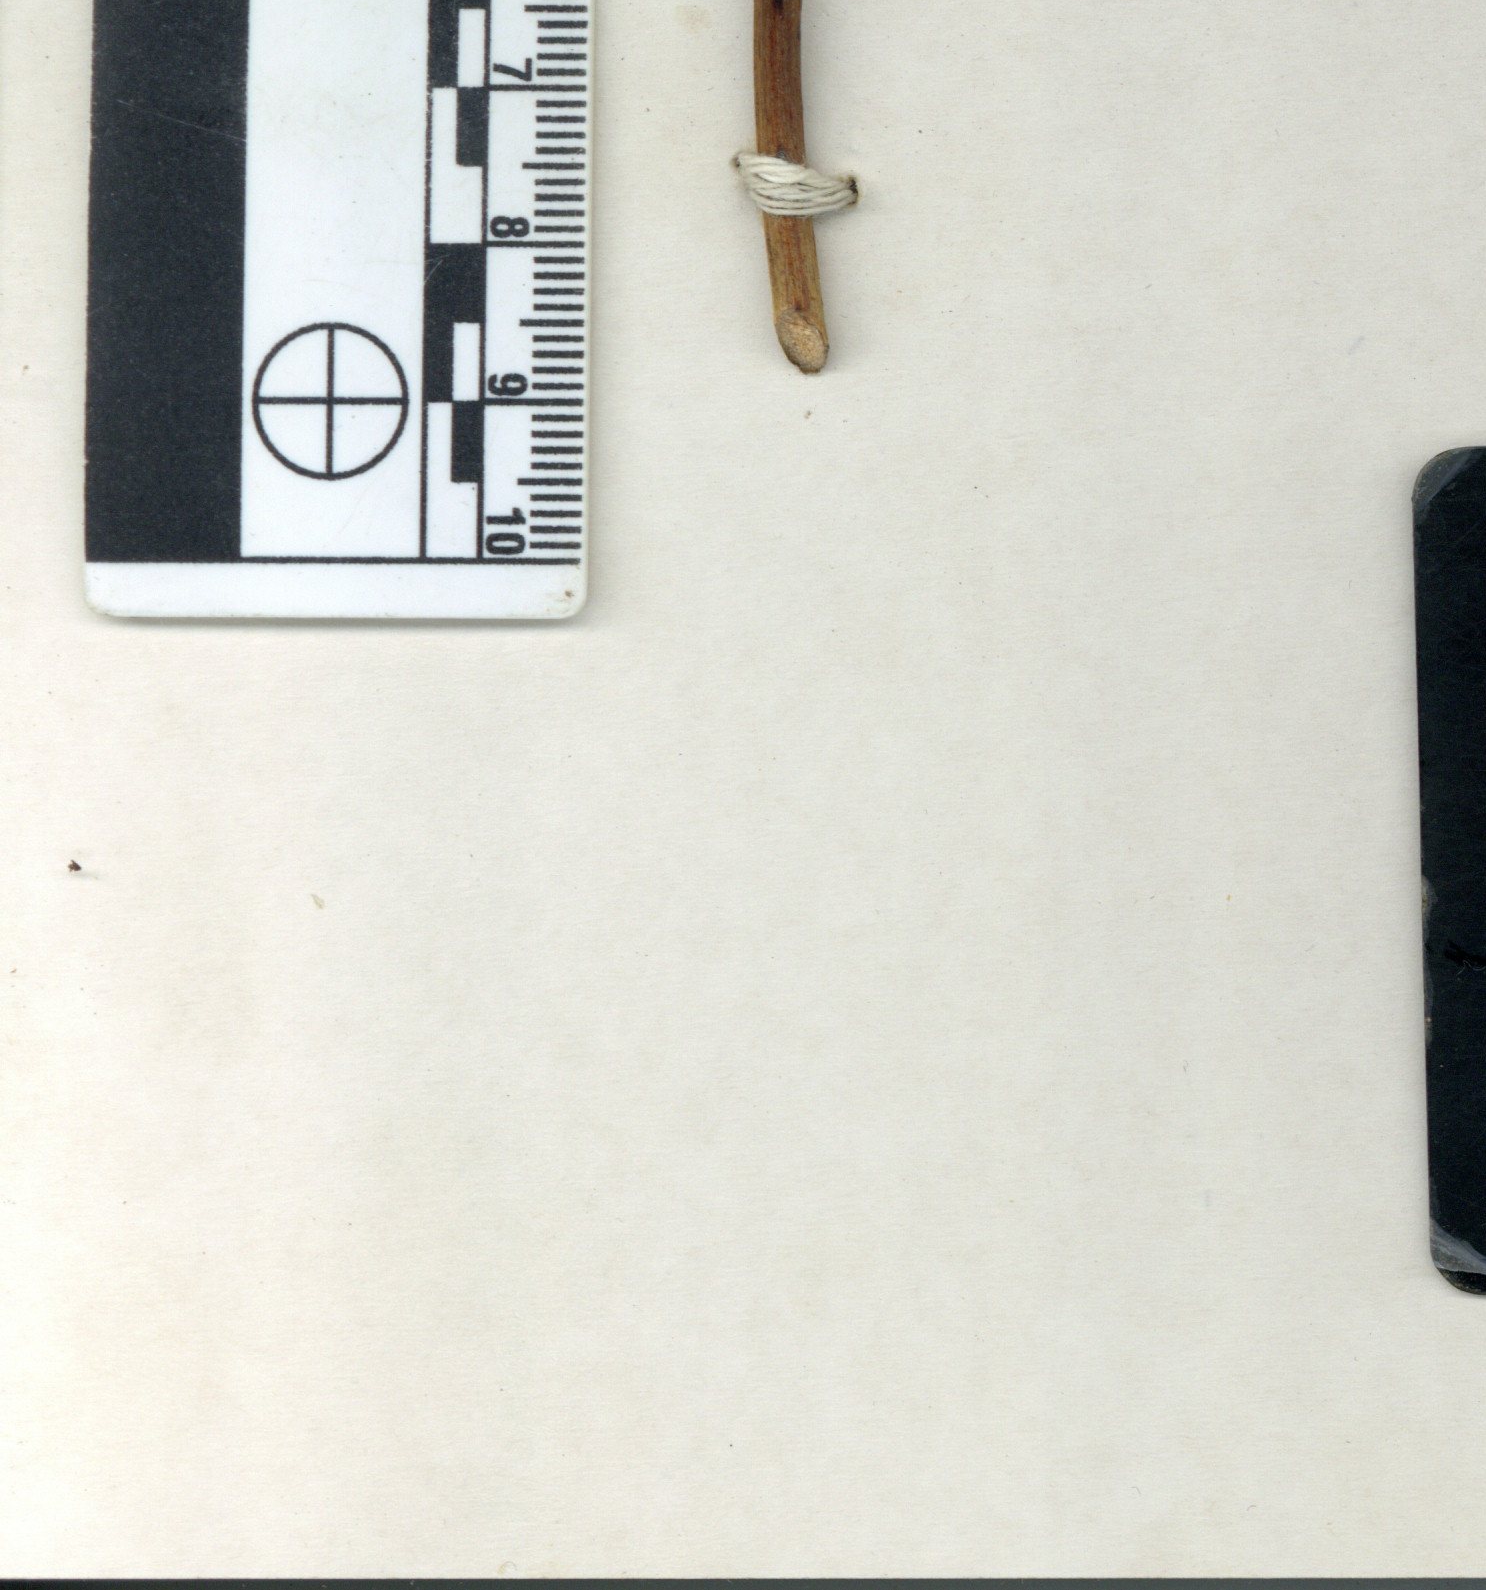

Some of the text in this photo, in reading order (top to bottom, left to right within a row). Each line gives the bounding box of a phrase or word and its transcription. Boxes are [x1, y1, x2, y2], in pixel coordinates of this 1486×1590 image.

[493, 57, 532, 82] 7
[489, 215, 531, 238] 8
[487, 372, 528, 396] 9
[485, 507, 527, 555] 10
